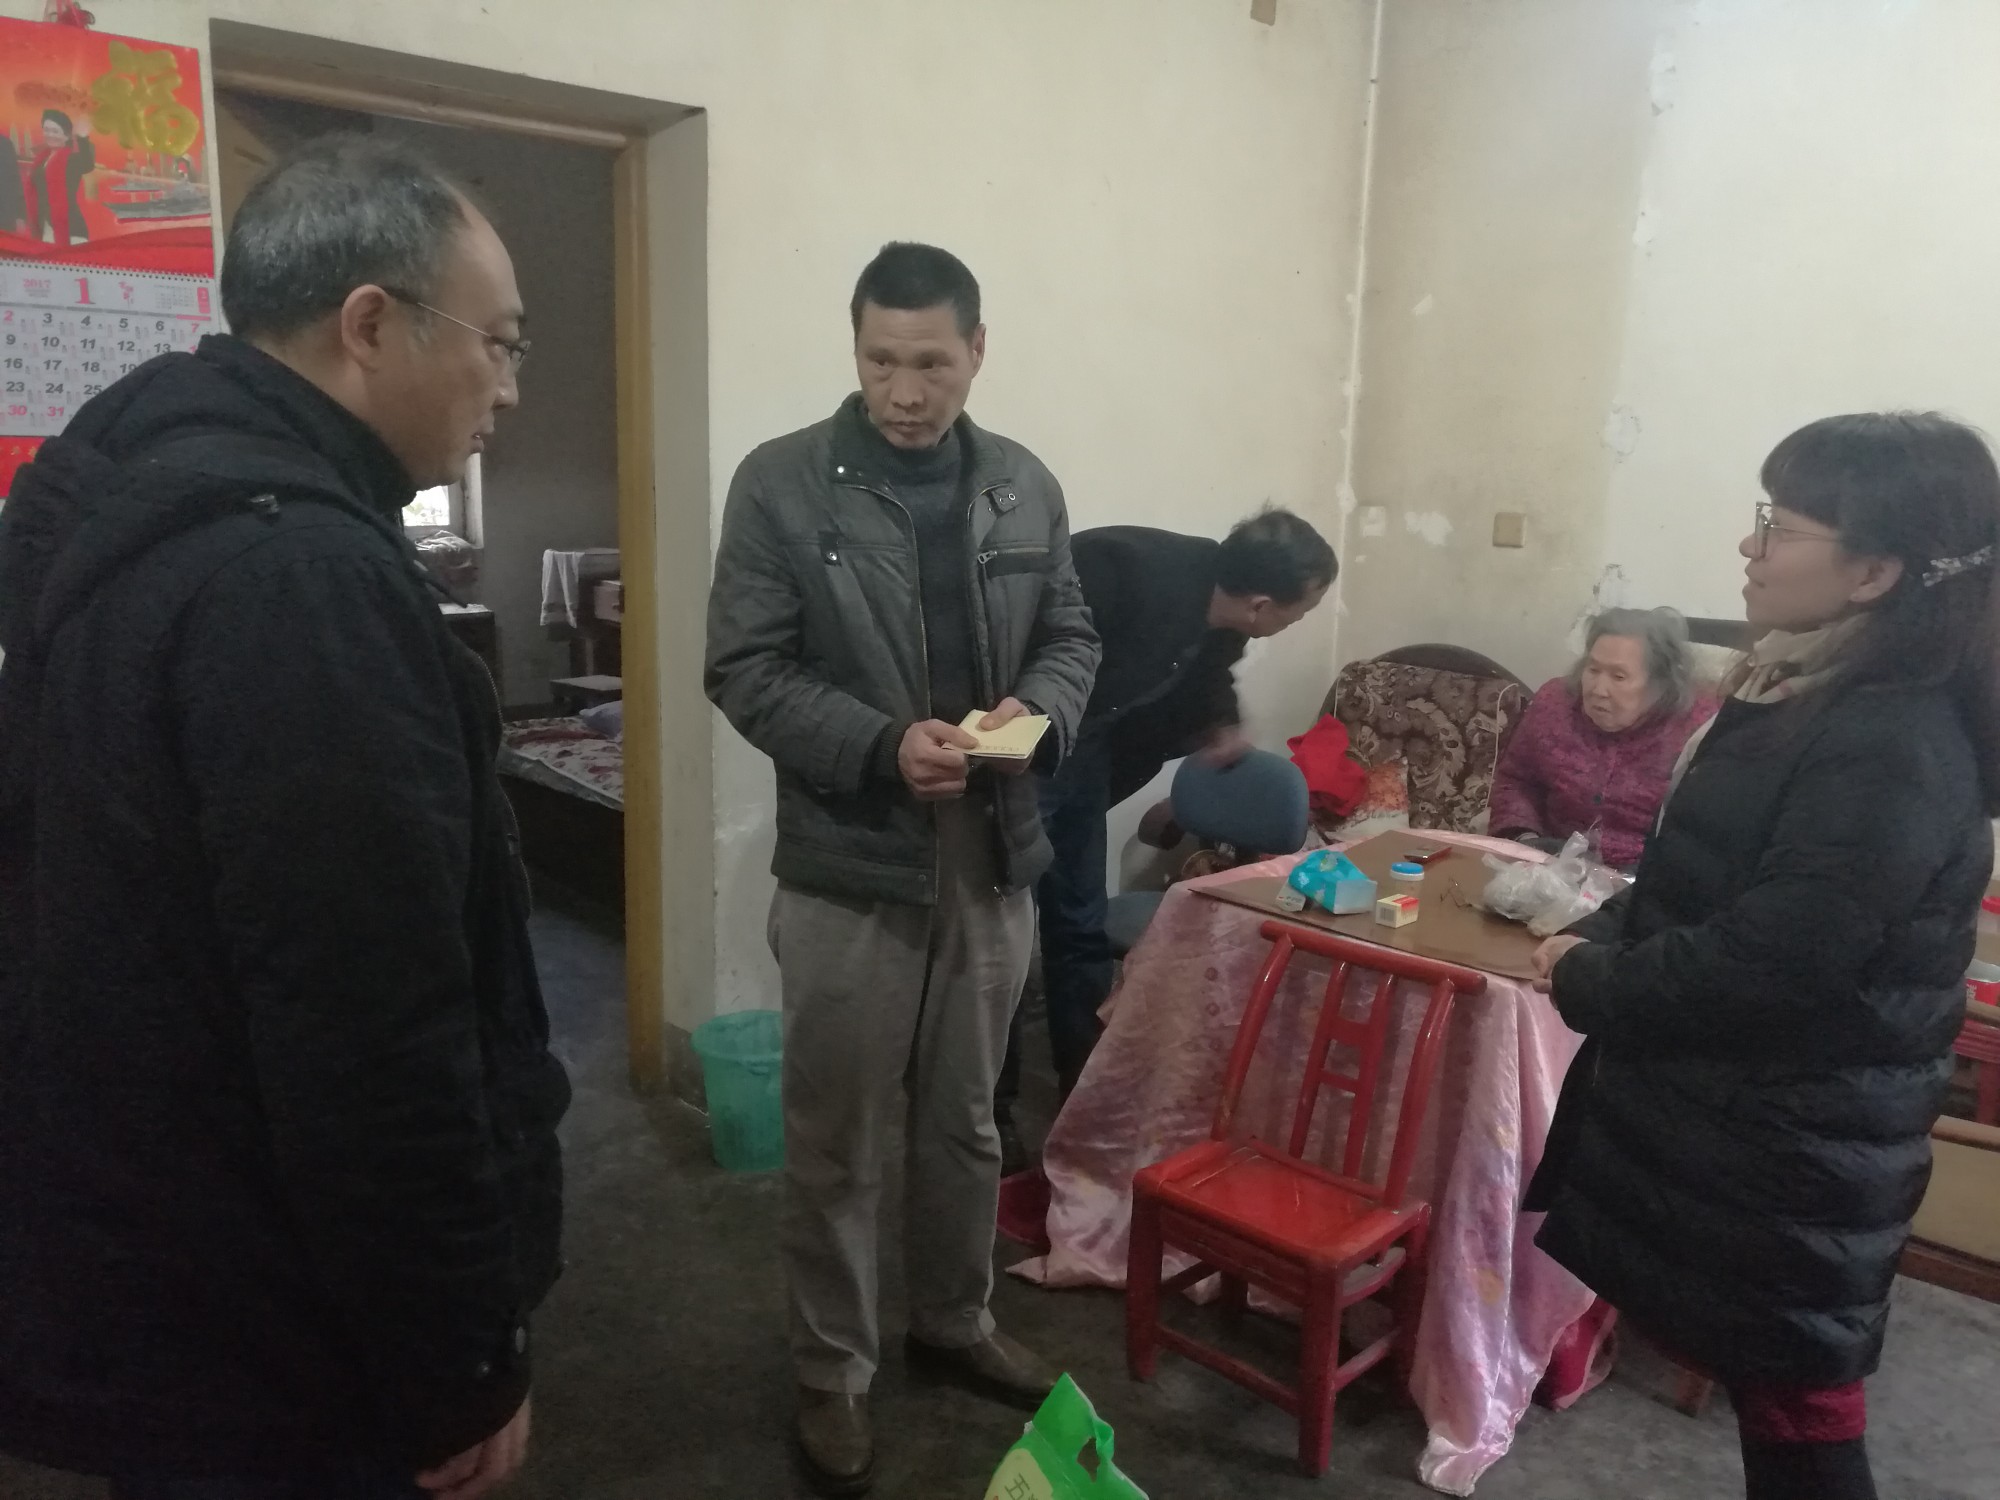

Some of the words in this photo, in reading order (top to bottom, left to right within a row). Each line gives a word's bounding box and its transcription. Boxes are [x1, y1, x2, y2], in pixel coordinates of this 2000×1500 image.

[23, 278, 51, 288] 2017
[74, 277, 96, 304] 1
[4, 310, 14, 321] 2
[43, 313, 53, 324] 3
[80, 315, 91, 326] 4
[119, 318, 129, 328] 5
[155, 320, 165, 331] 6
[191, 323, 200, 333] 7
[6, 334, 16, 345] 9
[41, 336, 60, 347] 10
[80, 338, 96, 349] 11
[117, 341, 135, 352] 12
[154, 343, 171, 354] 13
[4, 358, 23, 369] 16
[43, 360, 62, 370] 17
[81, 362, 100, 373] 18
[6, 381, 25, 392] 23
[45, 383, 64, 394] 24
[83, 385, 103, 396] 25
[7, 404, 27, 416] 30
[47, 406, 65, 417] 31
